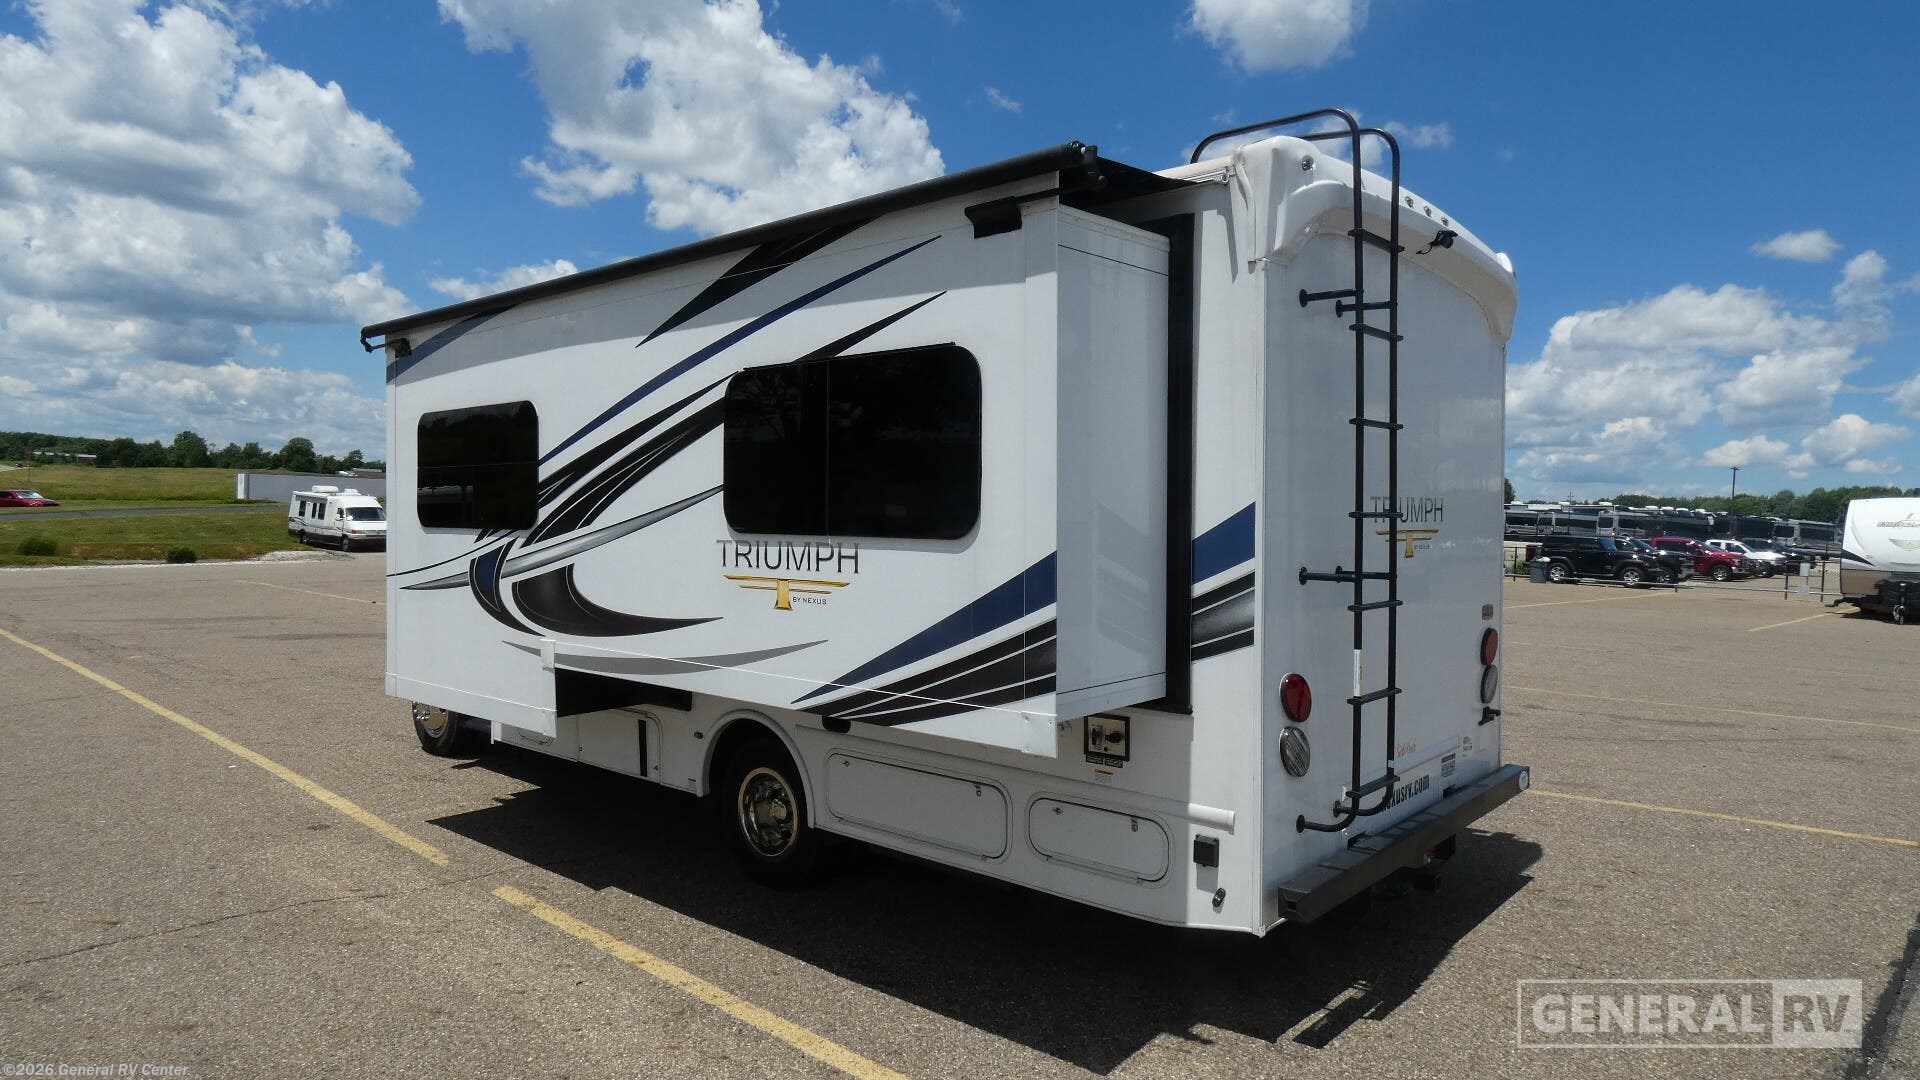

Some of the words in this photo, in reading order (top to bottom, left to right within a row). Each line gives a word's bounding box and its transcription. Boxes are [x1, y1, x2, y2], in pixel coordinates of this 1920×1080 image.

[1370, 496, 1444, 523] TUMPH
[716, 539, 860, 574] TRIUMPH
[802, 597, 827, 605] NEXUS
